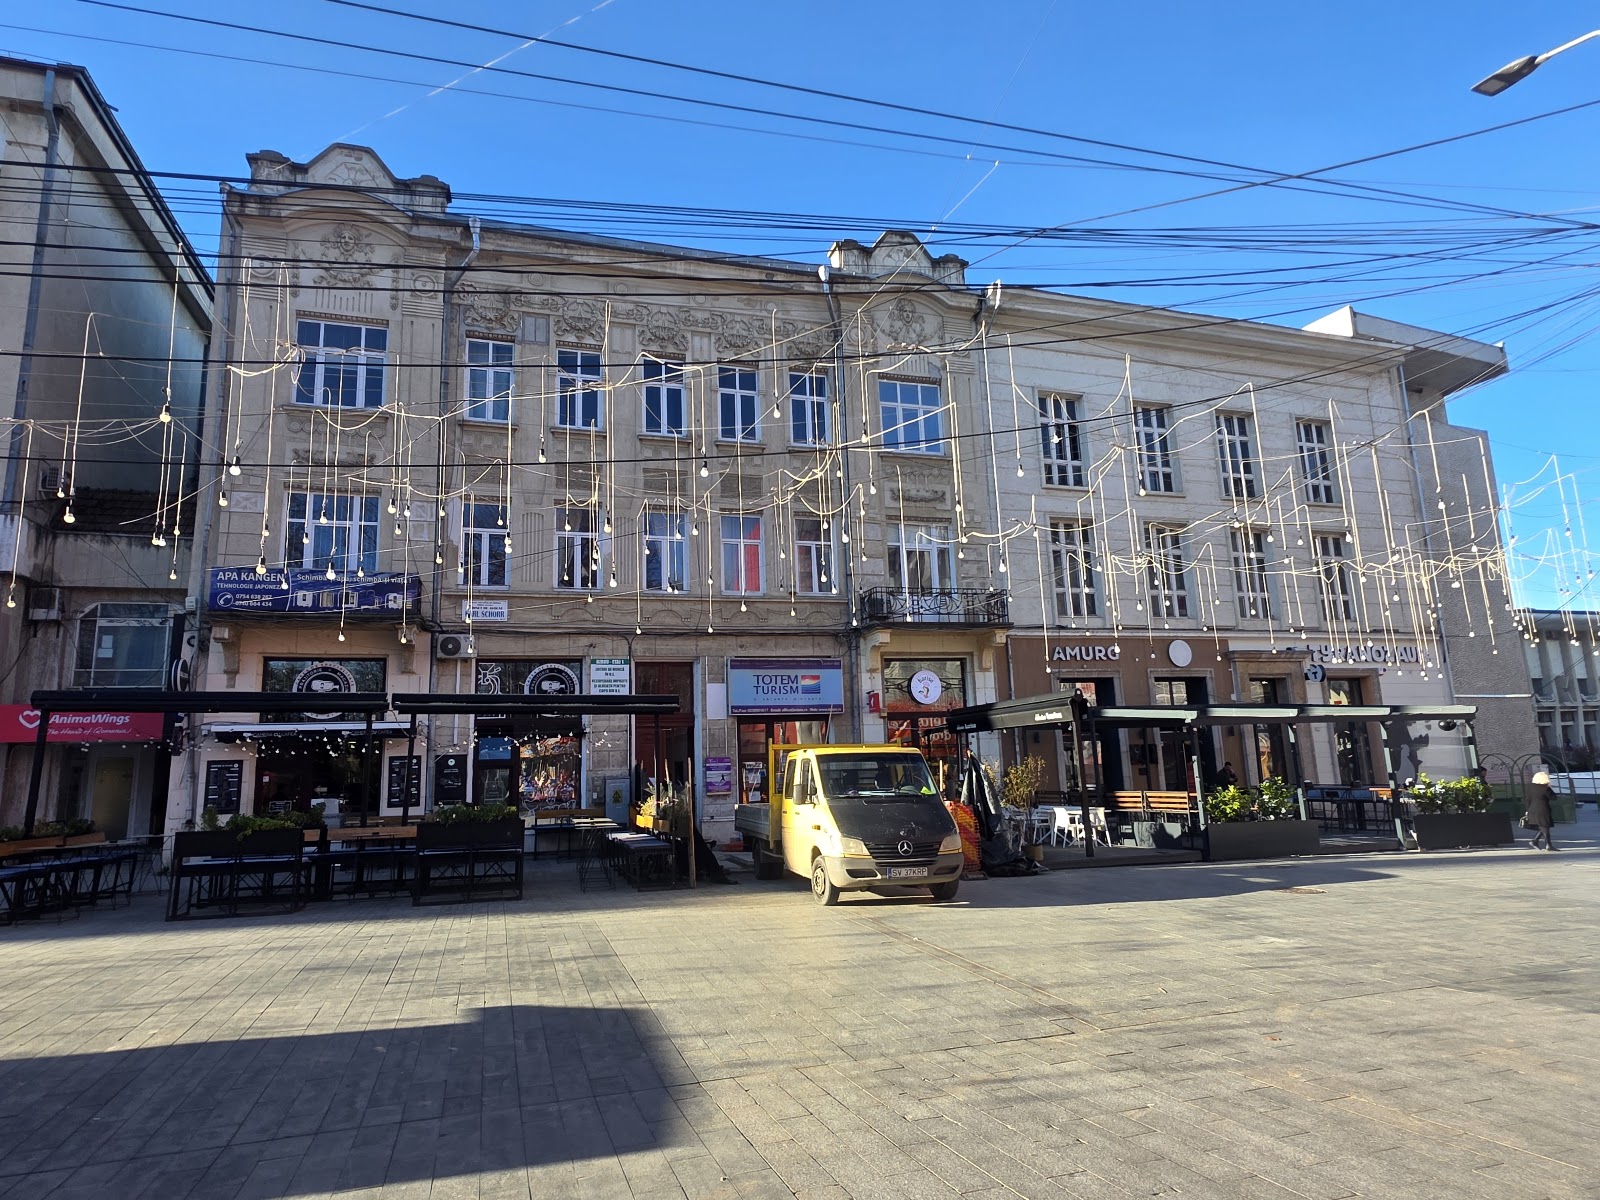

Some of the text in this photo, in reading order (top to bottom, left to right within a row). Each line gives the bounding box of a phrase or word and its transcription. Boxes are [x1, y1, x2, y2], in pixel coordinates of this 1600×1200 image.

[241, 572, 285, 582] KANGEN
[481, 610, 505, 618] SCHORR
[1052, 645, 1120, 661] AMURG
[753, 674, 799, 685] TOTEM
[753, 685, 799, 695] TURISM
[49, 713, 131, 725] AnimaWings
[84, 727, 92, 736] of
[92, 726, 132, 735] Romania
[892, 868, 902, 877] SV
